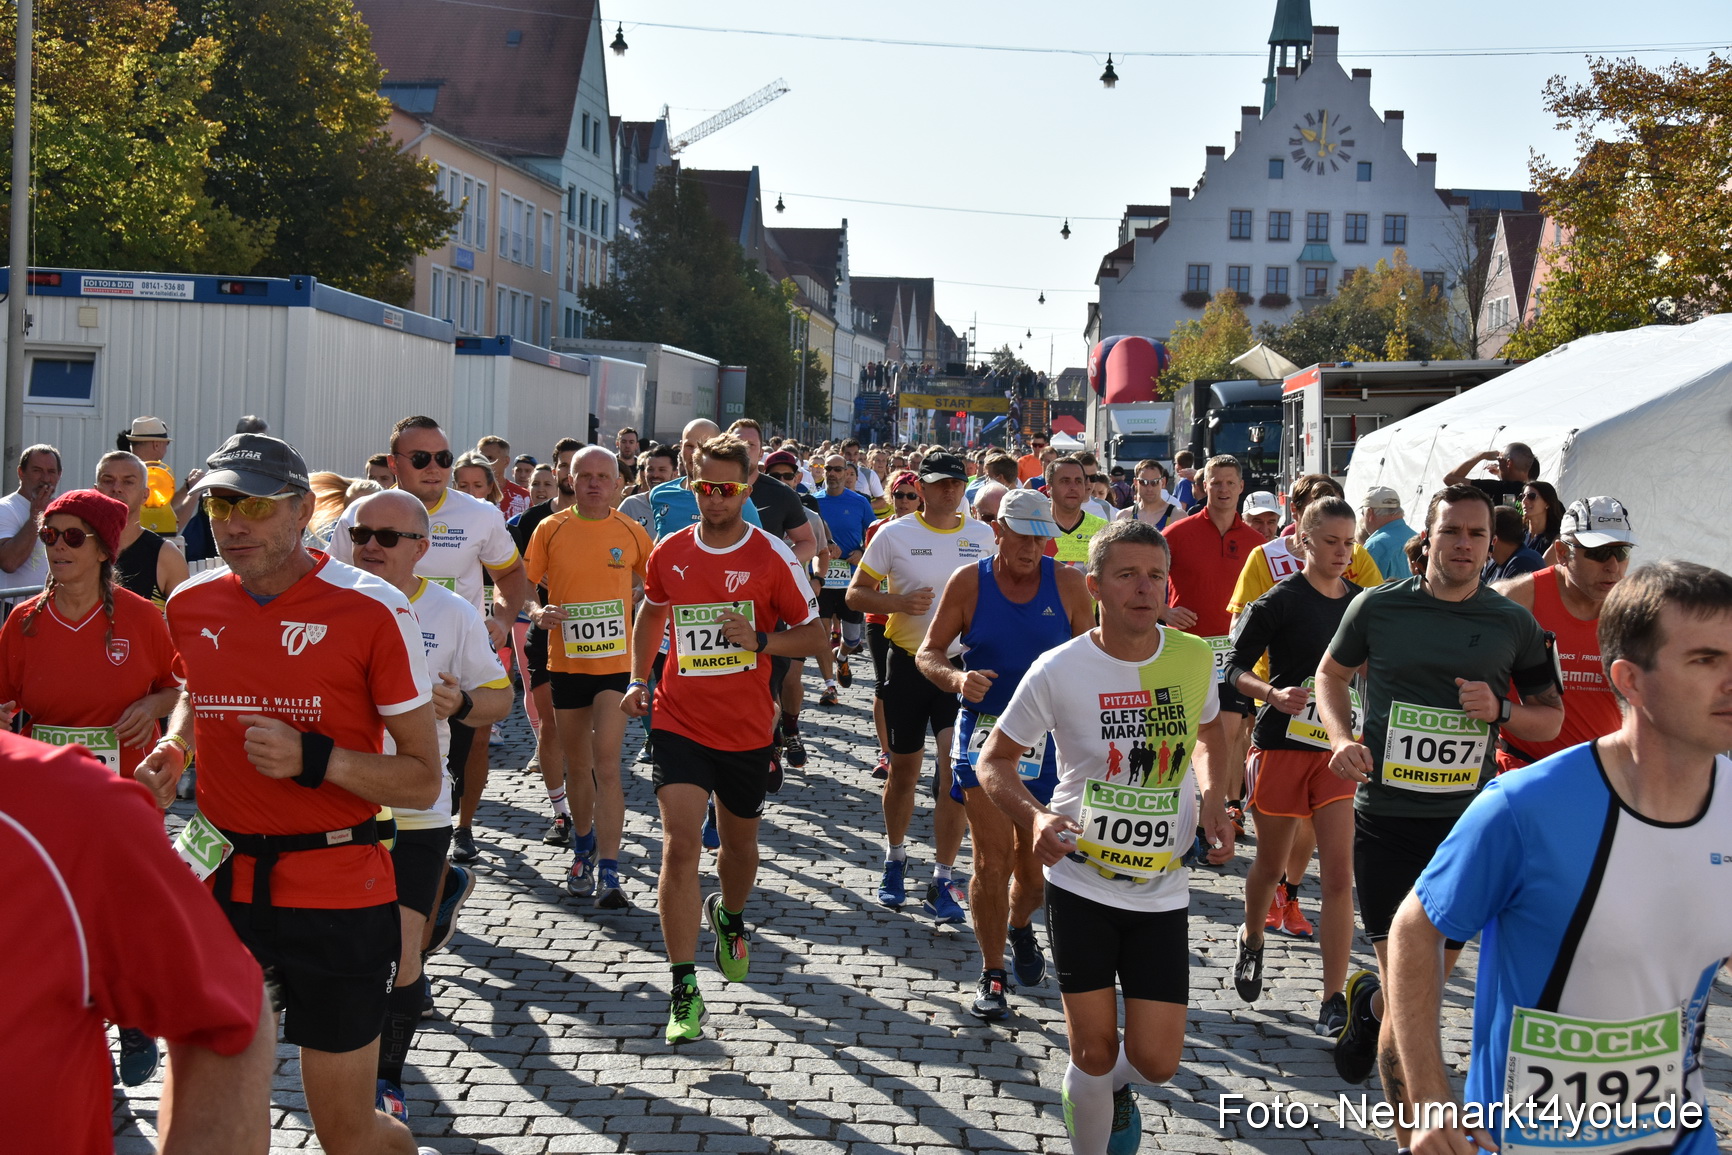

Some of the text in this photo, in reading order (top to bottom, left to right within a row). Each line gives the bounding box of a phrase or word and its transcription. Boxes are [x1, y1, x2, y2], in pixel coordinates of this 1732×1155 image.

[141, 281, 160, 290] 08141
[164, 282, 176, 291] 536
[176, 283, 185, 291] 80
[935, 398, 973, 408] START
[432, 525, 447, 534] 20
[431, 541, 461, 549] Stadtlauf
[911, 548, 932, 556] BOCK
[567, 603, 618, 618] BOCK
[570, 619, 618, 640] 1015
[576, 642, 615, 652] ROLAND
[685, 628, 742, 651] 124
[692, 655, 741, 668] MARCEL
[192, 692, 257, 705] ENGELHARDT
[262, 697, 269, 705] &
[1103, 694, 1148, 706] PITZTAL
[277, 707, 322, 715] HERRENHAUS
[292, 714, 321, 722] Lauf
[1100, 704, 1186, 725] GLETSCHER
[1398, 707, 1481, 732] BOCK
[1101, 720, 1188, 740] MARATHON
[38, 729, 109, 747] BOCK
[1399, 735, 1476, 765] 1067
[1392, 767, 1471, 783] CHRISTIAN
[1092, 786, 1173, 812] BOCK
[1093, 815, 1169, 848] 1099
[1100, 849, 1154, 868] FRANZ
[1521, 1015, 1668, 1058] BOCK
[1666, 1064, 1674, 1072] D
[1526, 1064, 1662, 1112] 2192
